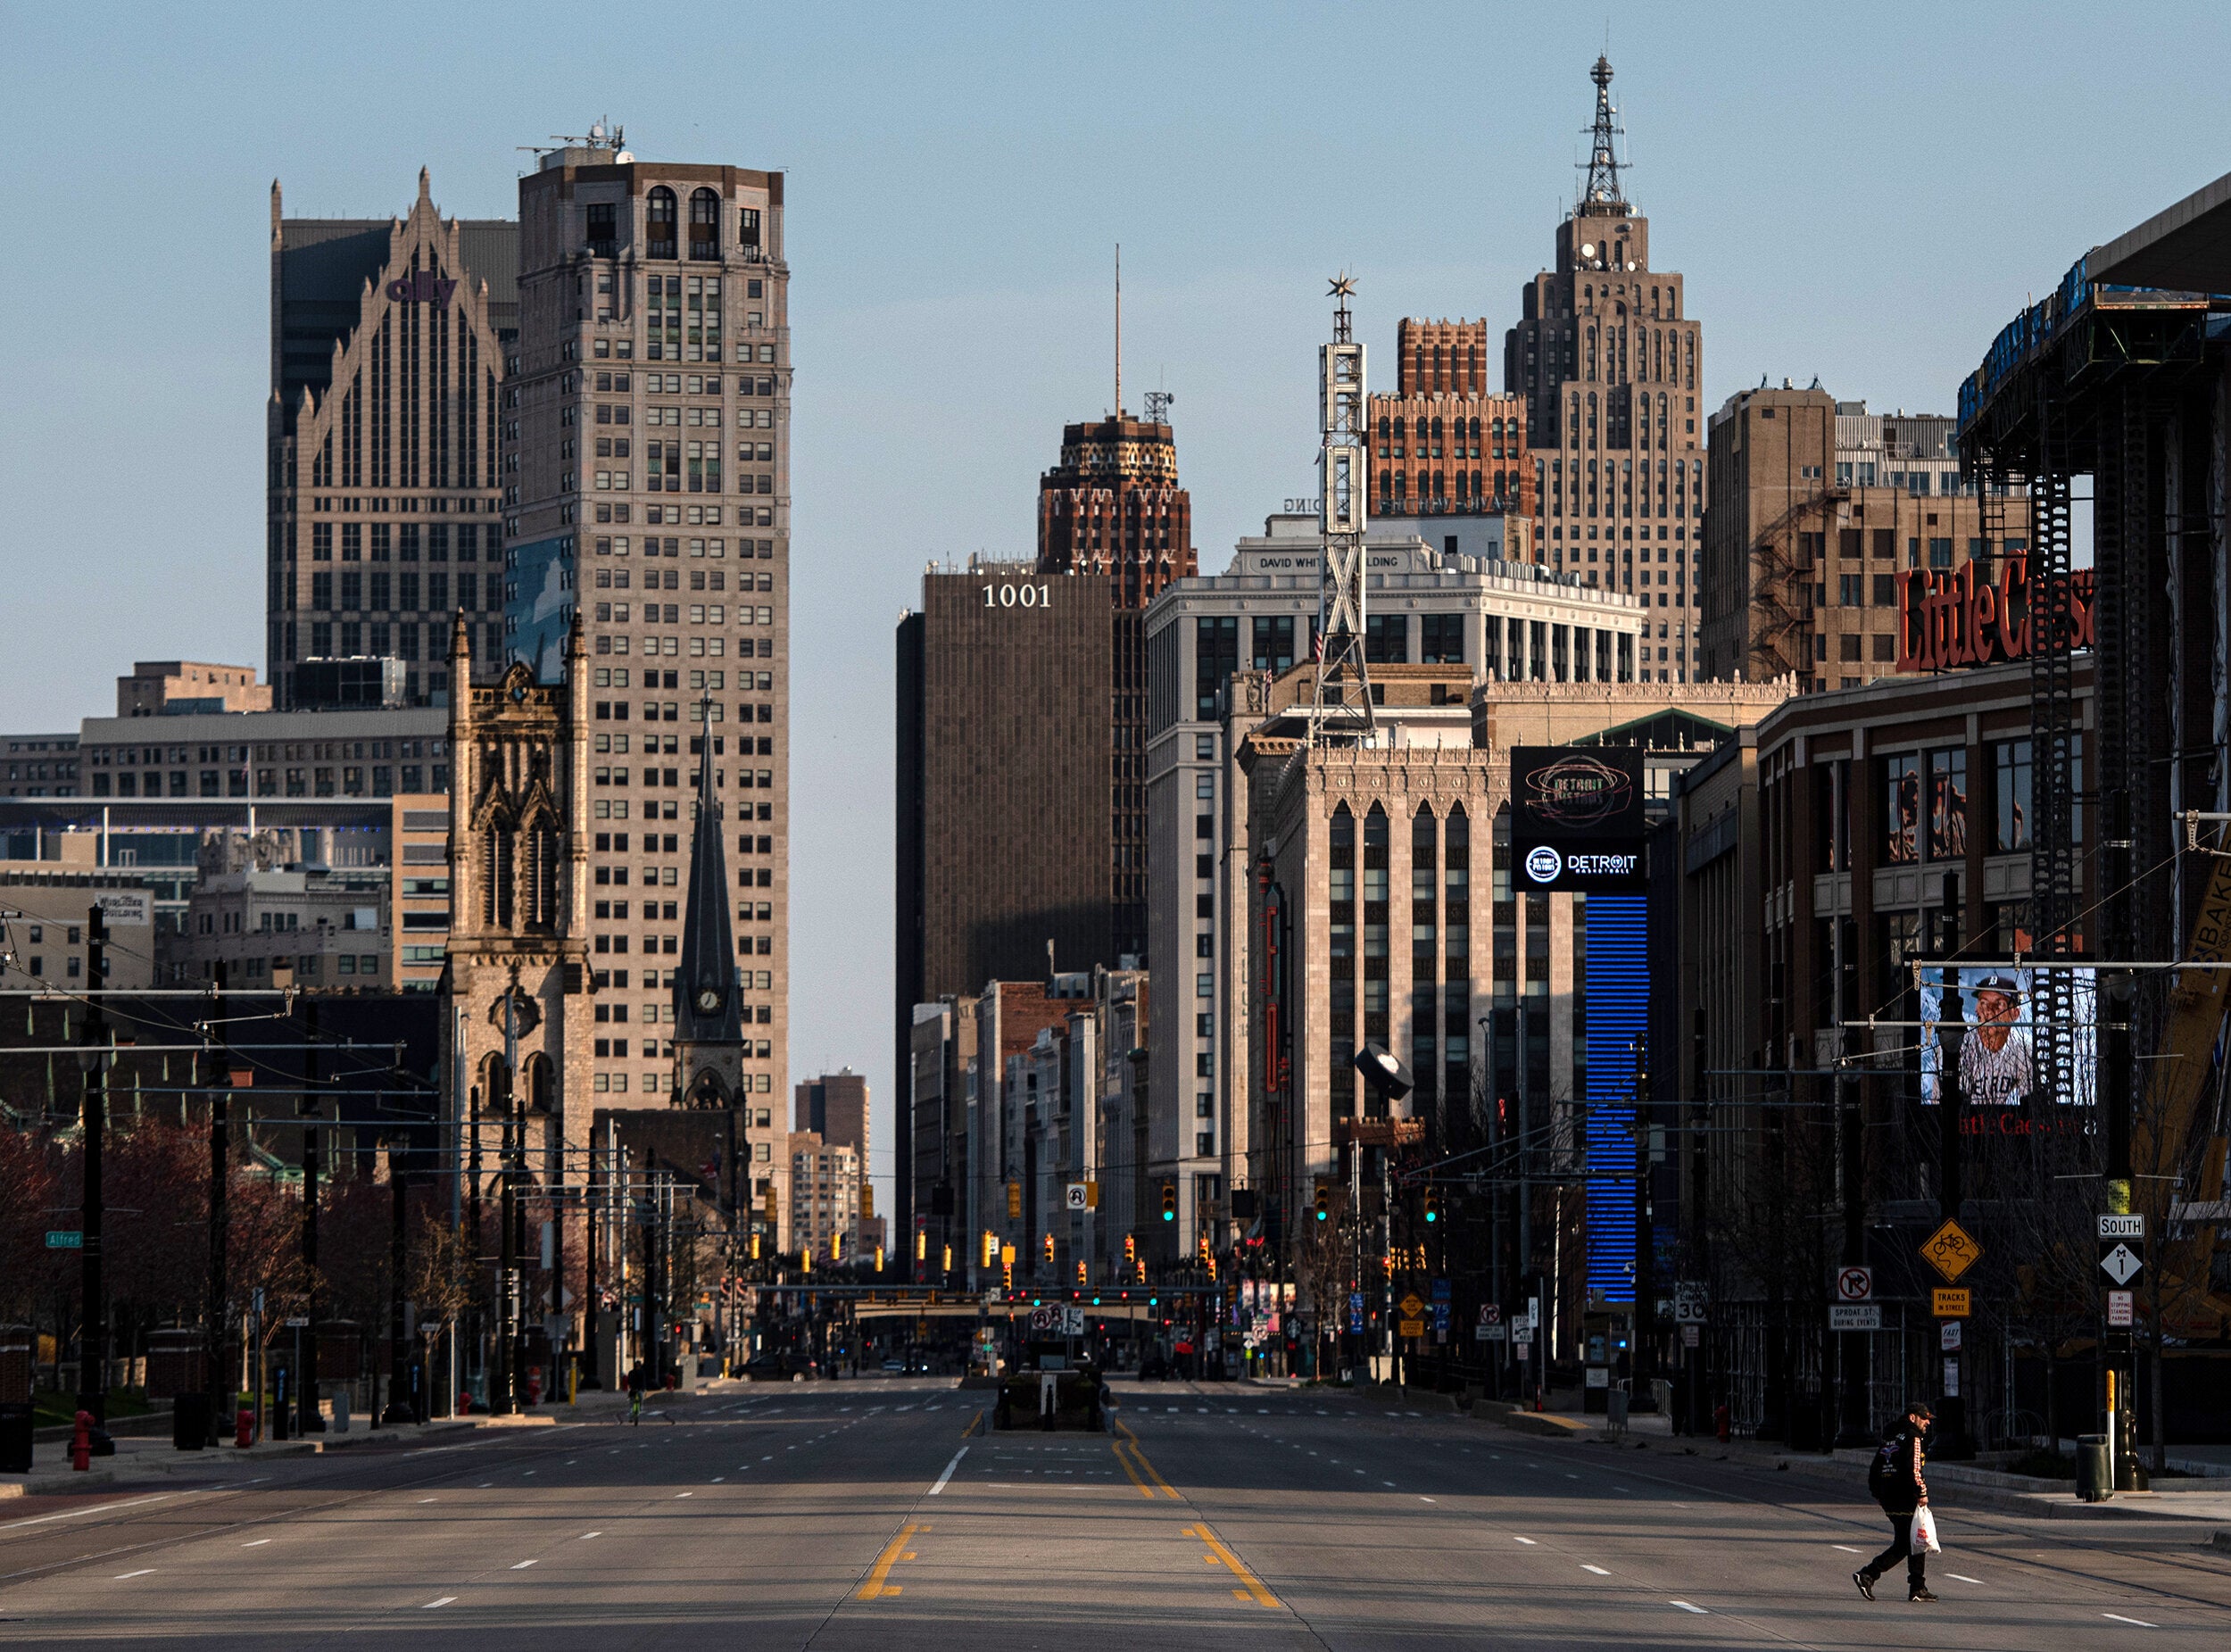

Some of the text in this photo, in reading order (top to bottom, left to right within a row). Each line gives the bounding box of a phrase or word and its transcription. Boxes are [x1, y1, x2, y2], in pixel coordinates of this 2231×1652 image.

[1260, 558, 1292, 568] DAVID
[983, 584, 1051, 608] 1001
[1895, 557, 1995, 673] Little
[1555, 778, 1603, 792] DETROIT
[1568, 854, 1638, 869] DETROIT
[2102, 1218, 2141, 1233] SOUTH
[50, 1234, 79, 1246] Alfred
[2116, 1249, 2127, 1258] M
[2119, 1258, 2124, 1275] 1
[1434, 1304, 1449, 1315] 75
[1679, 1303, 1705, 1319] 30
